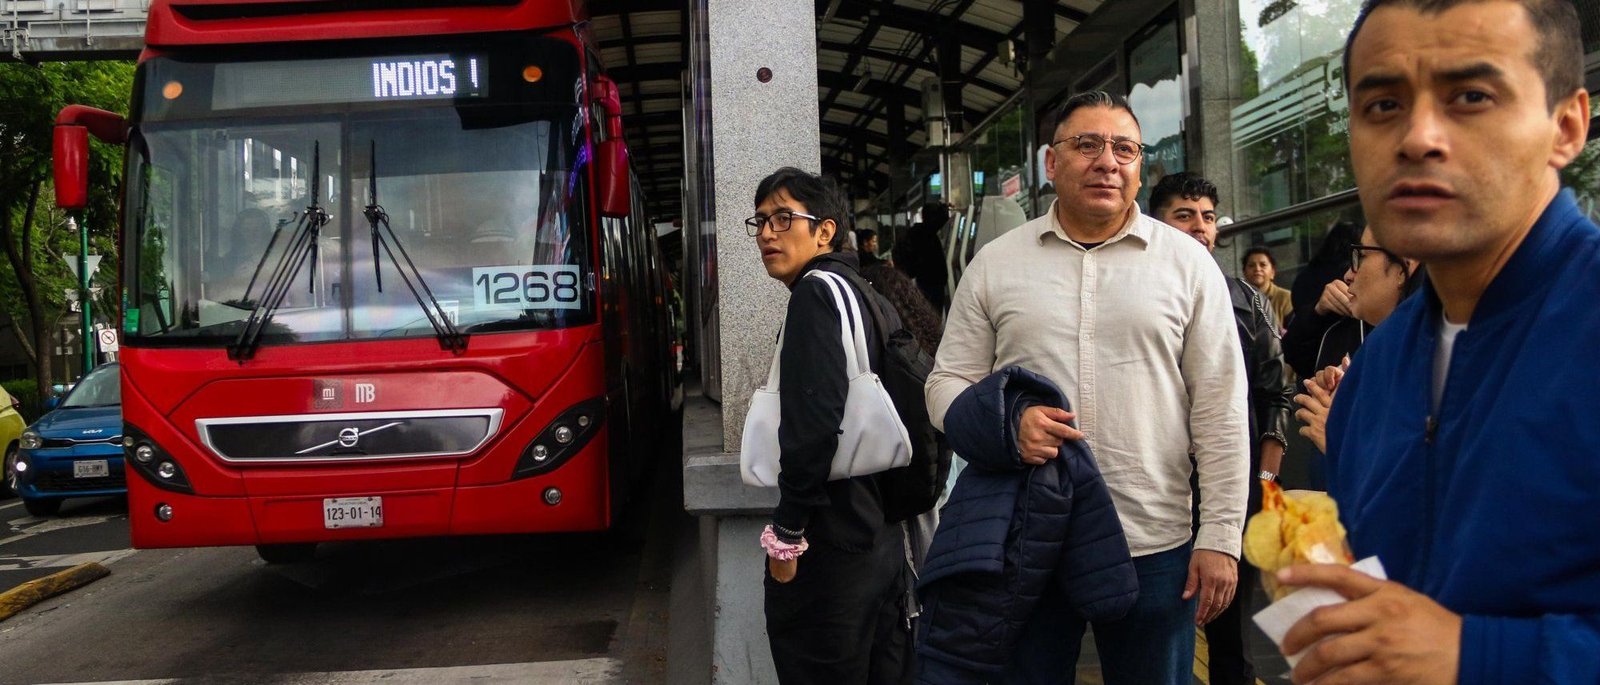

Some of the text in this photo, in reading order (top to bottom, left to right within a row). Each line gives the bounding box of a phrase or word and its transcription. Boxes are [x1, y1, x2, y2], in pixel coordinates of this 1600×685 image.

[373, 60, 456, 97] INDIOS
[476, 271, 578, 304] 1268
[327, 506, 381, 520] 123-01-14
